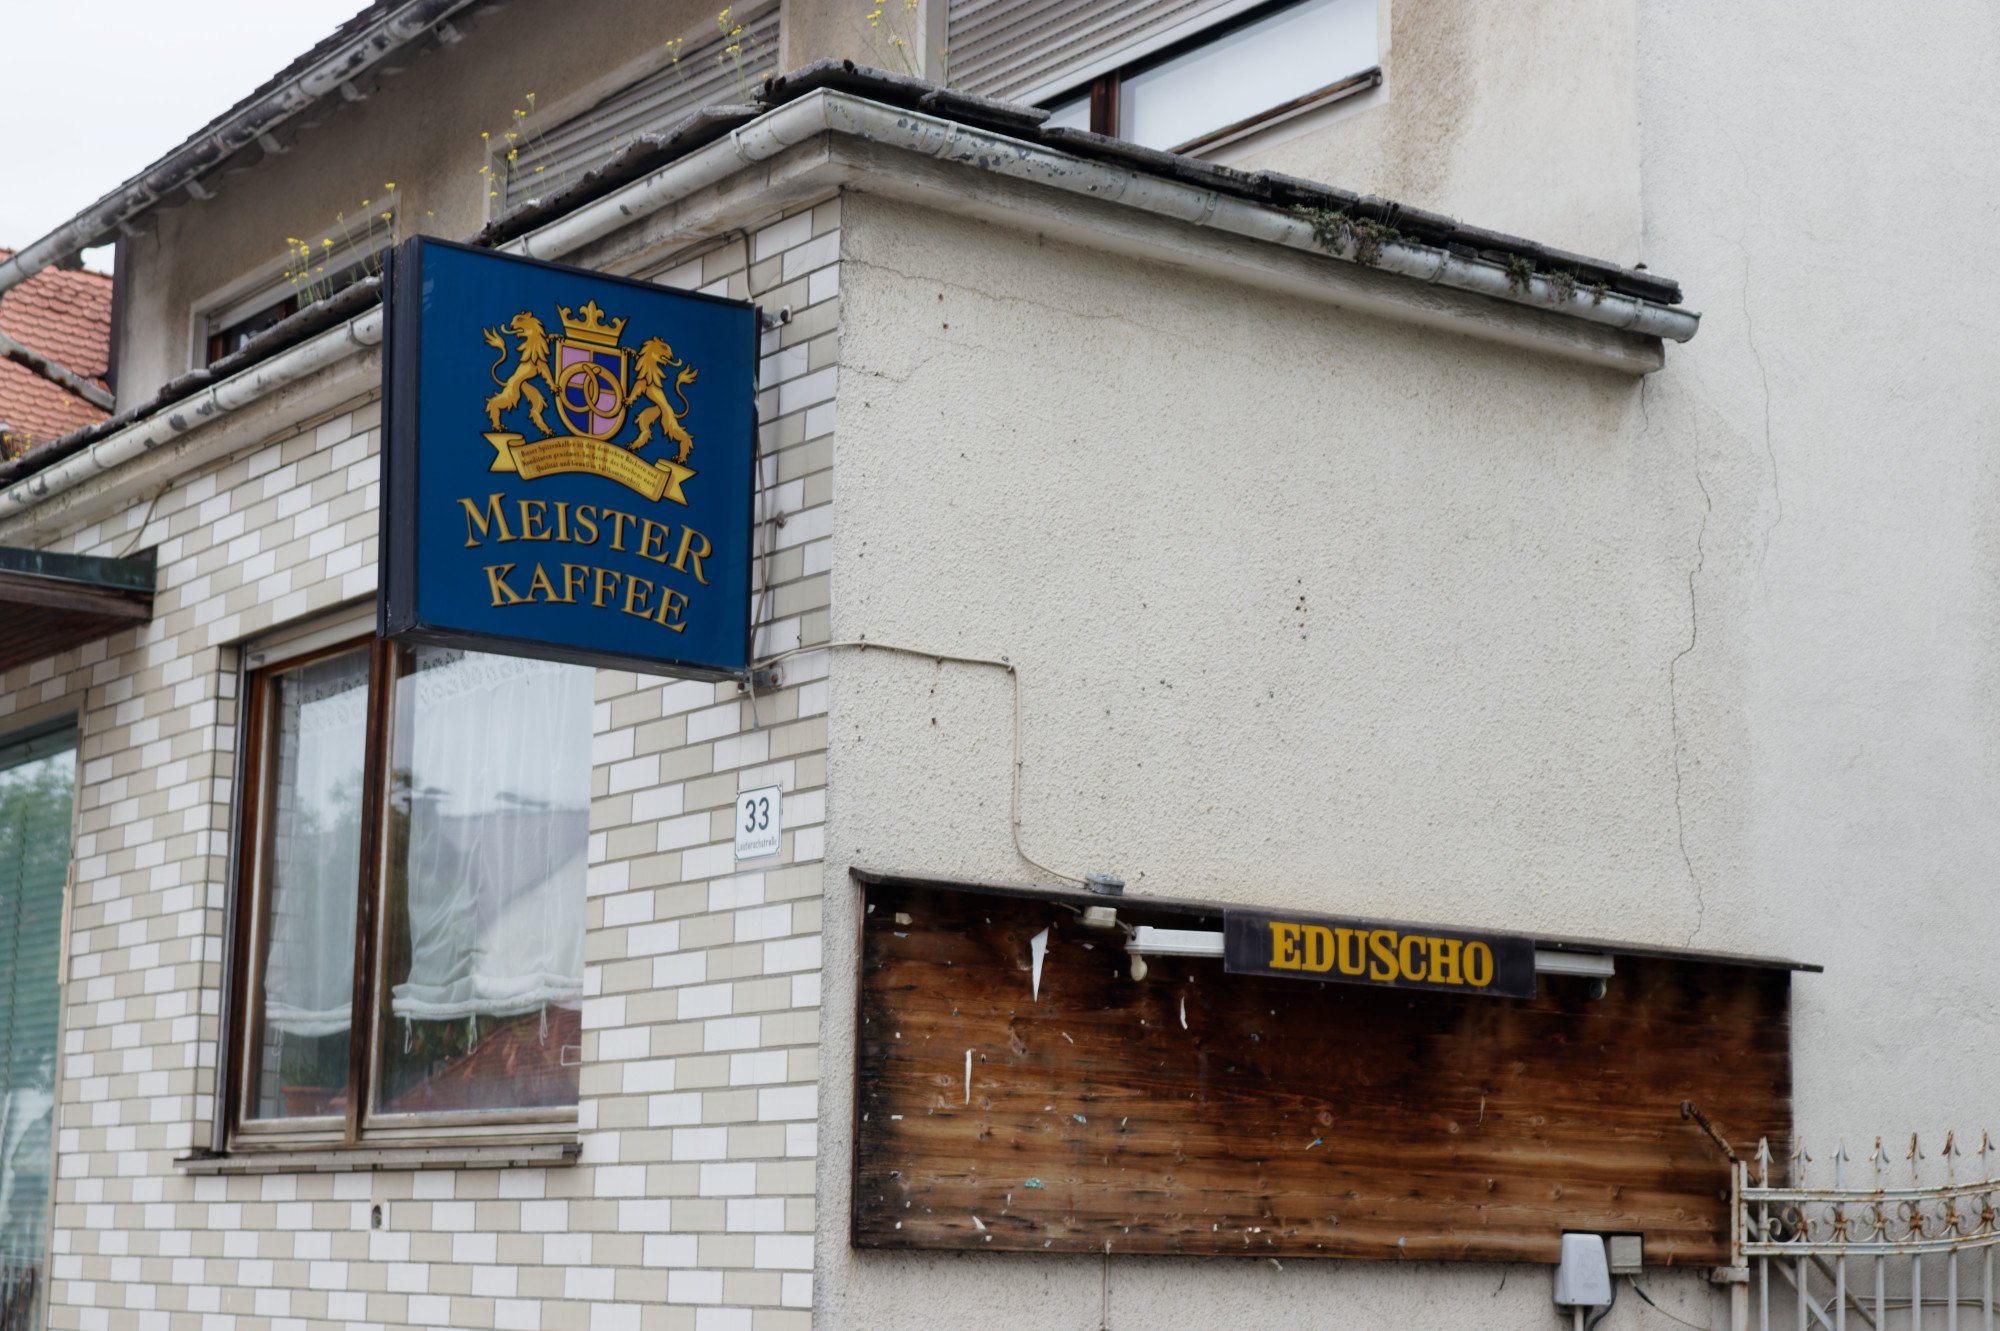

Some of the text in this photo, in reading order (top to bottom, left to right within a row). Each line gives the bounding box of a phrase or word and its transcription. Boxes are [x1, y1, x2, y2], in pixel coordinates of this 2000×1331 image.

[457, 492, 713, 586] MEISTER
[483, 562, 690, 633] KAFFEE
[745, 797, 769, 832] 33
[1268, 921, 1493, 987] EDUSCHO
